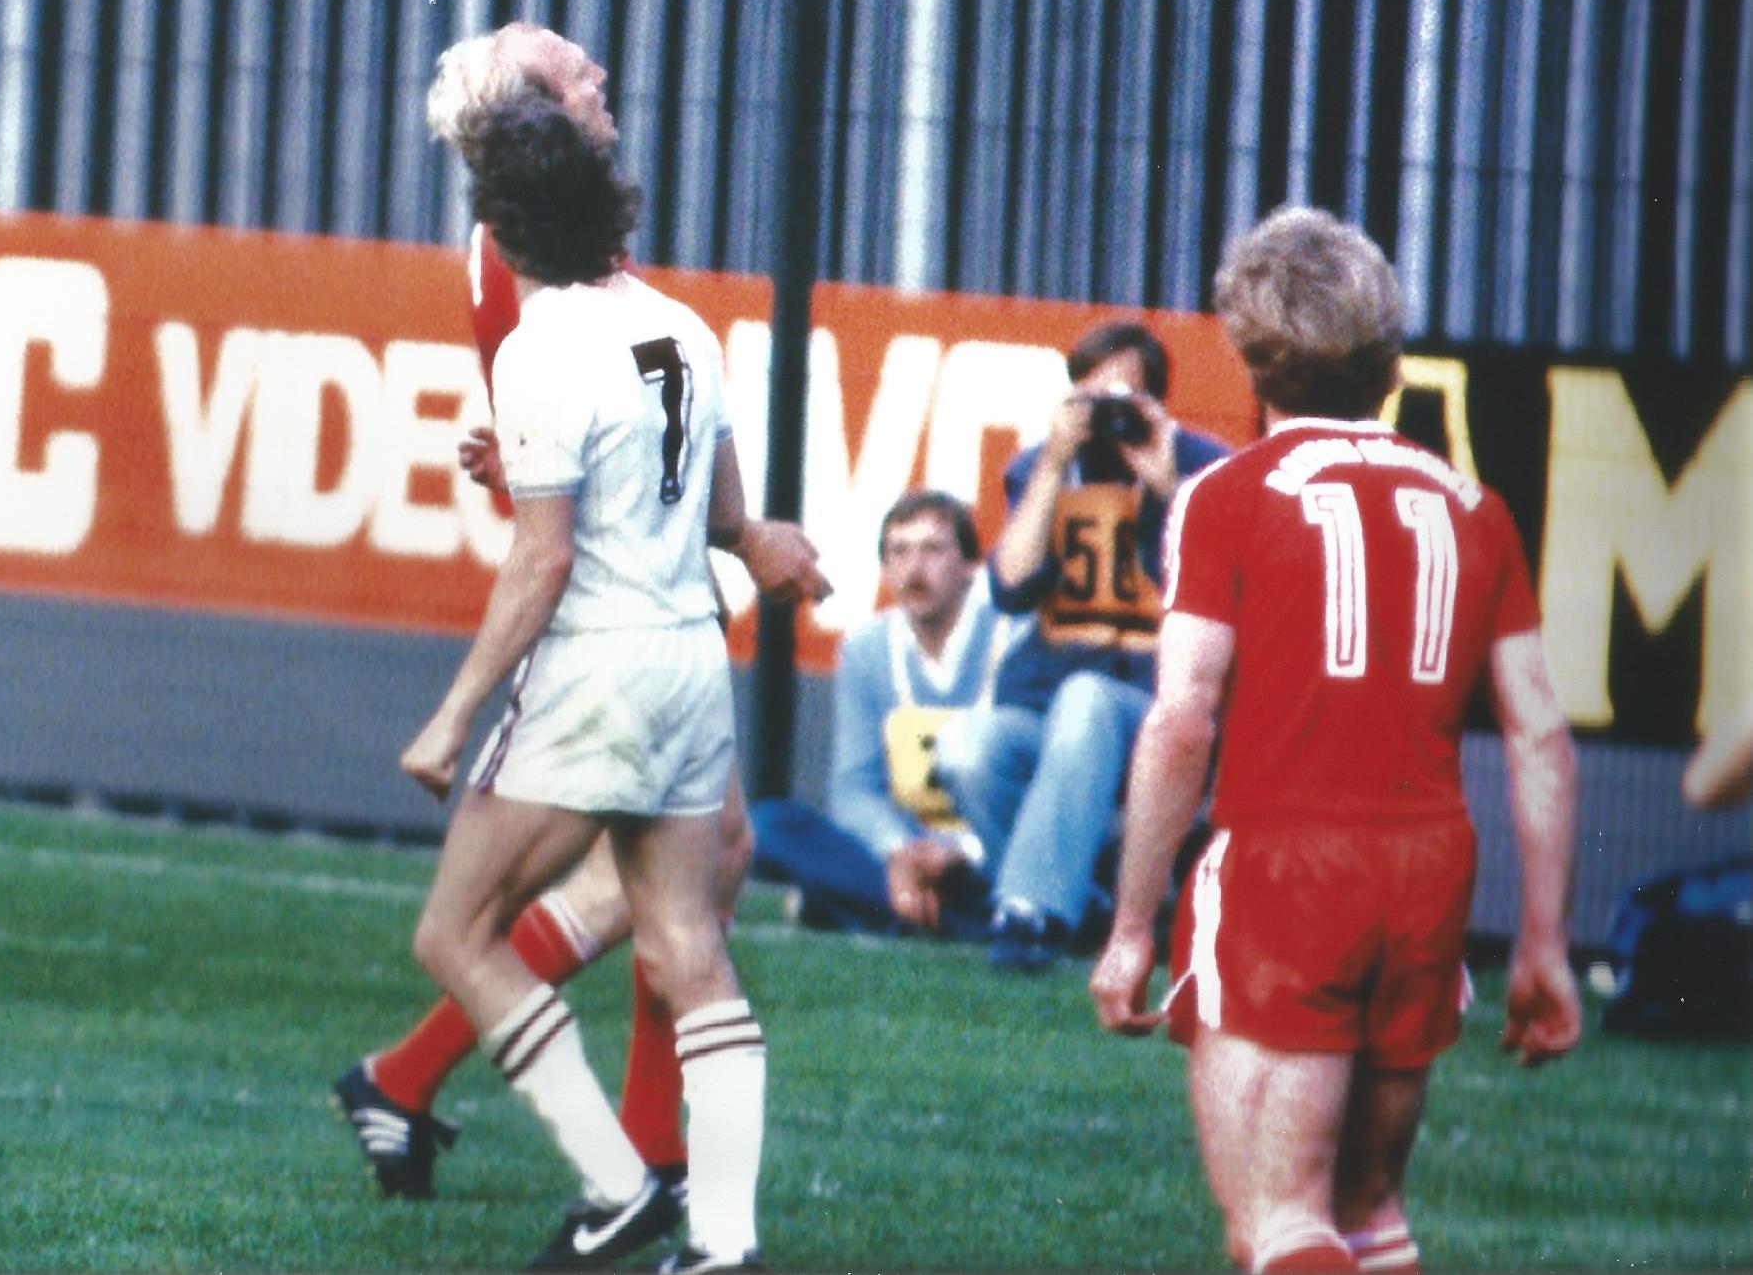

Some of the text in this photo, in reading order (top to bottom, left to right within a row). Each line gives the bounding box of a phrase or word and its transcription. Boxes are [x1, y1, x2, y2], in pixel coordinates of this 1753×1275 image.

[154, 320, 514, 567] VIDE
[630, 336, 694, 505] 7
[1300, 482, 1459, 685] 11
